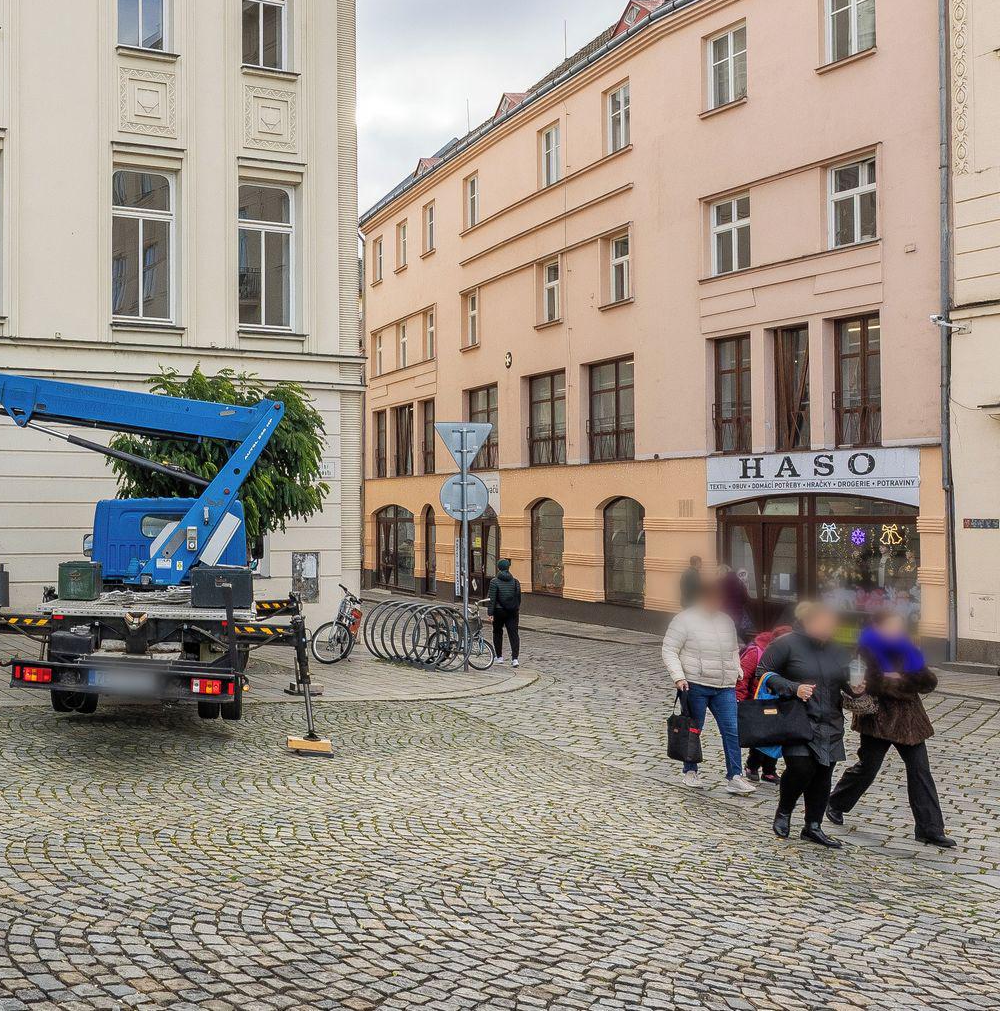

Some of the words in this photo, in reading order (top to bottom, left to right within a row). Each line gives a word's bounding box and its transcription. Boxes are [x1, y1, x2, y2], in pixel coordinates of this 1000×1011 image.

[739, 453, 876, 479] HASO
[774, 480, 801, 488] POTŘEBY
[806, 479, 831, 488] HRAČKY
[838, 479, 871, 487] DROGERIE
[877, 478, 915, 487] POTRAVINY
